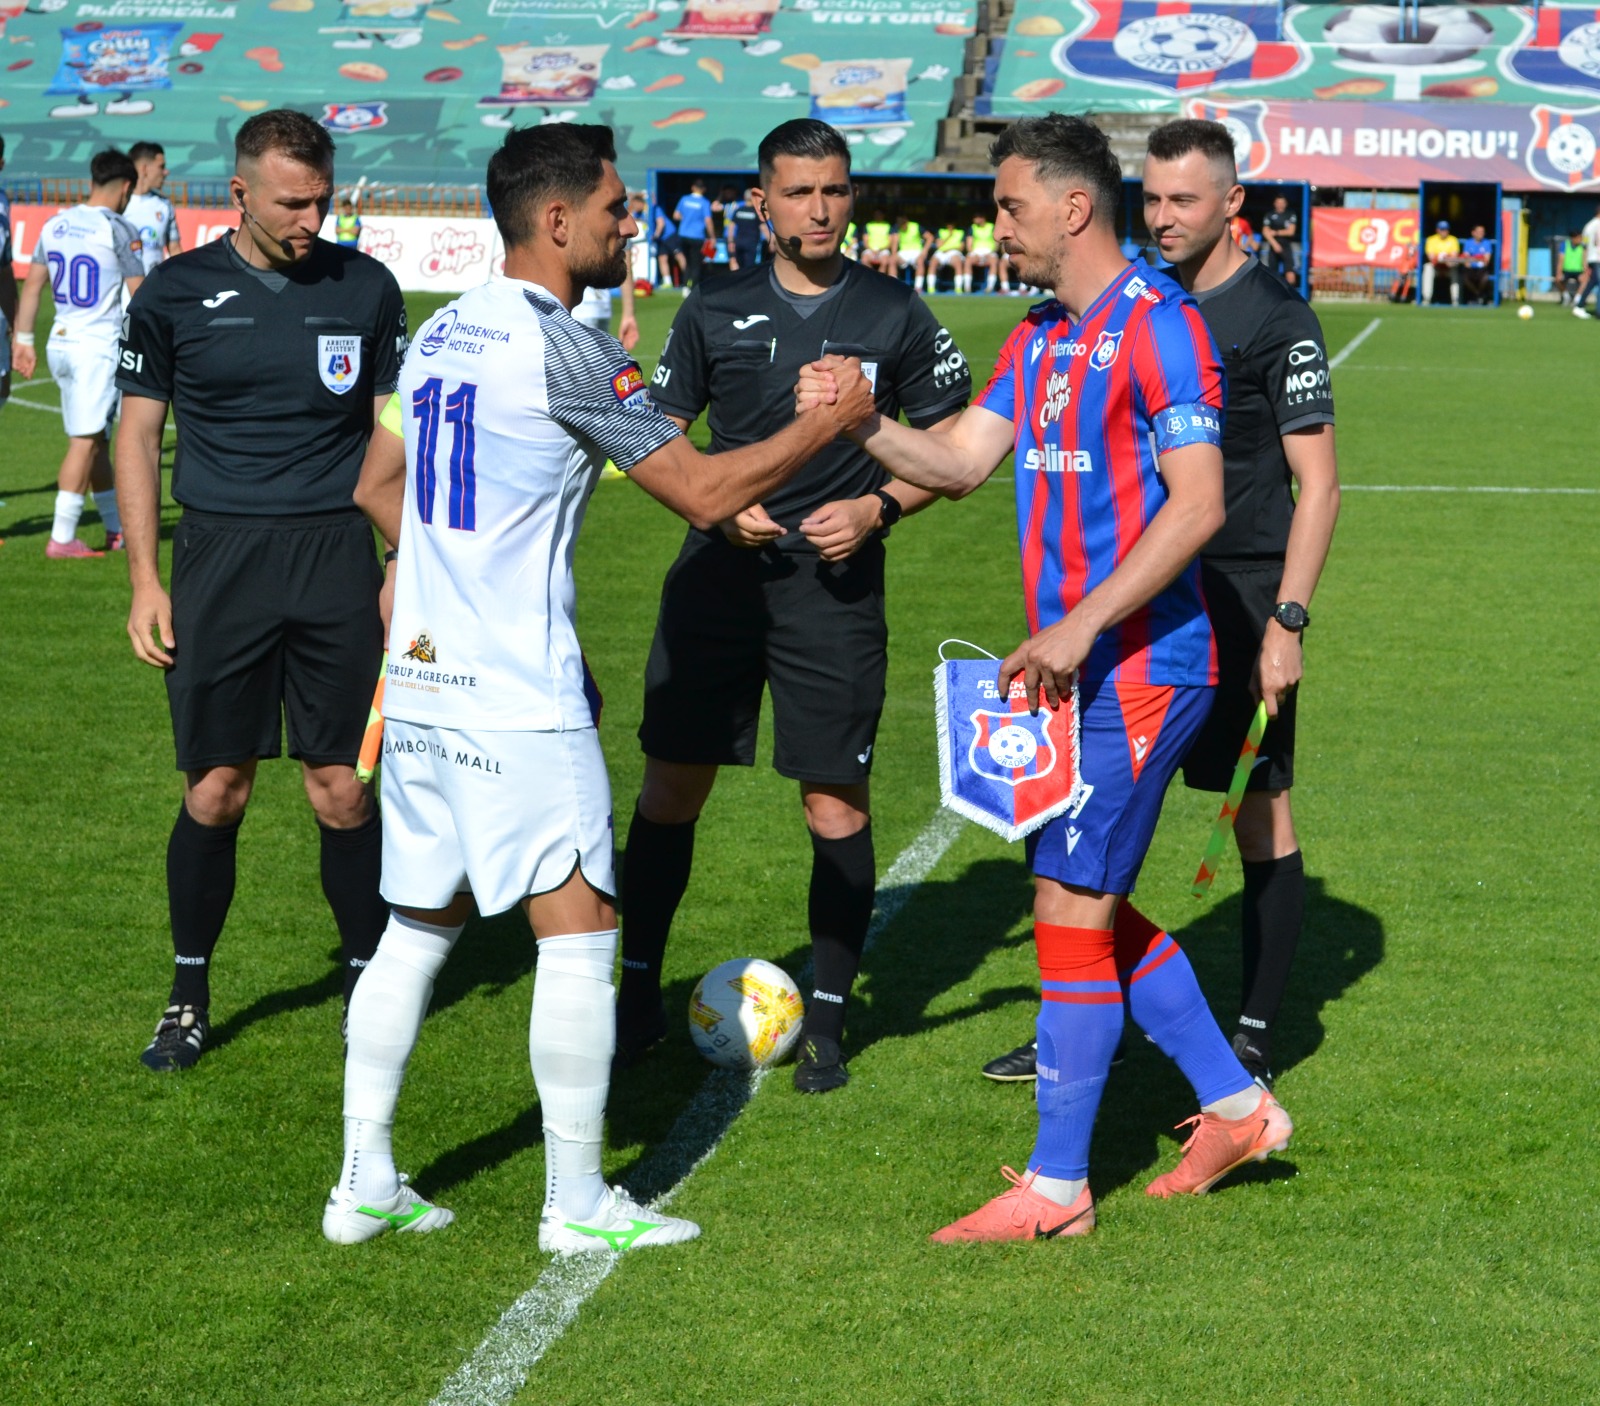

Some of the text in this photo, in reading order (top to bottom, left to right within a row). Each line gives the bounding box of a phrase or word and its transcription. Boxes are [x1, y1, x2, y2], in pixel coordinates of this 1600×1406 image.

[1279, 127, 1343, 156] HAI
[47, 251, 100, 308] 20
[453, 322, 510, 344] PHOENICIA
[118, 346, 144, 373] SI
[447, 339, 485, 355] HOTELS
[1046, 370, 1069, 400] Viva
[1039, 386, 1072, 428] Chips
[412, 376, 478, 532] 11
[1023, 442, 1093, 473] selina
[415, 669, 477, 687] AGREGATE
[976, 679, 995, 689] FC
[454, 751, 502, 775] MALL
[995, 754, 1032, 767] ORADEA
[812, 989, 844, 1004] Joma
